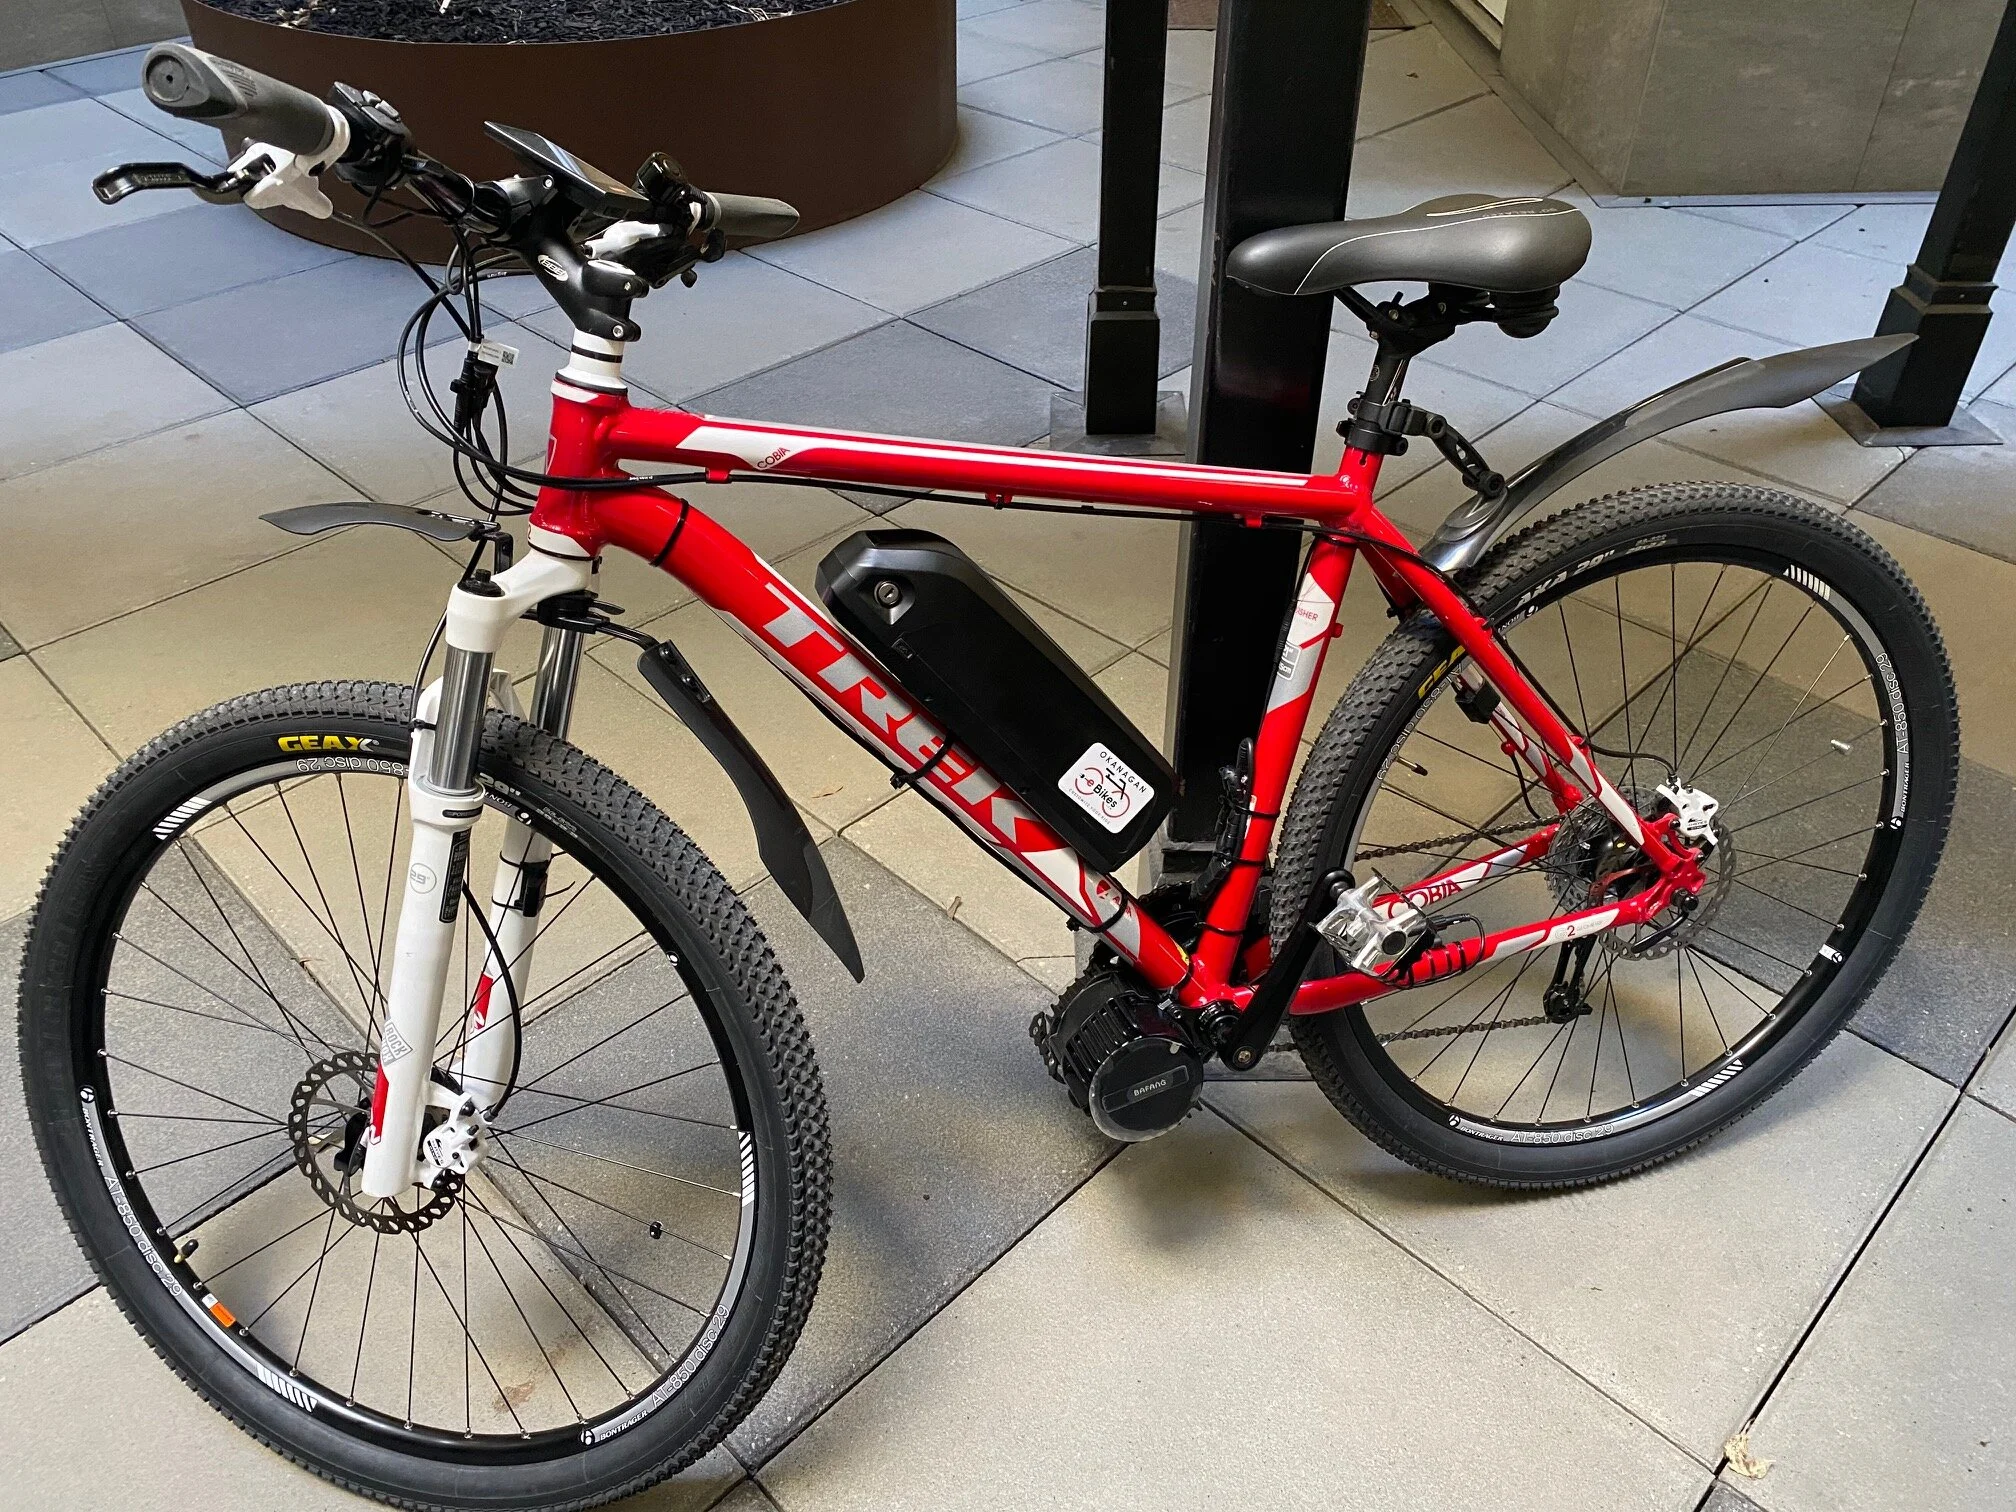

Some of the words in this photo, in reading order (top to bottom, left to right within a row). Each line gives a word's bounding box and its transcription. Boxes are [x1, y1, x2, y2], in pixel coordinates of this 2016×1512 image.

[757, 447, 790, 470] COBIA
[1512, 571, 1568, 611] AKA
[1296, 608, 1318, 621] SHER
[1418, 645, 1466, 699] GEA
[1876, 652, 1892, 672] 29
[1886, 672, 1901, 700] disc
[762, 582, 1043, 844] TREK
[1892, 702, 1909, 754] AT-850
[296, 758, 321, 772] 29
[324, 756, 361, 770] disc
[1100, 751, 1147, 793] OKANAGAN
[385, 1026, 407, 1056] ROCK
[1133, 1079, 1167, 1096] BAFANG
[1460, 1126, 1504, 1142] BONTRAGER
[1511, 1131, 1561, 1144] AT-850
[1564, 1129, 1593, 1143] disc
[1595, 1123, 1614, 1137] 29
[82, 1108, 103, 1167] BONTRAGER
[104, 1176, 143, 1238] AT-850
[137, 1235, 163, 1273] disc
[160, 1274, 183, 1296] 29
[600, 1410, 648, 1441] BONTRAGER
[651, 1359, 697, 1408] AT-850
[694, 1329, 718, 1361] disc
[712, 1304, 730, 1330] 29
